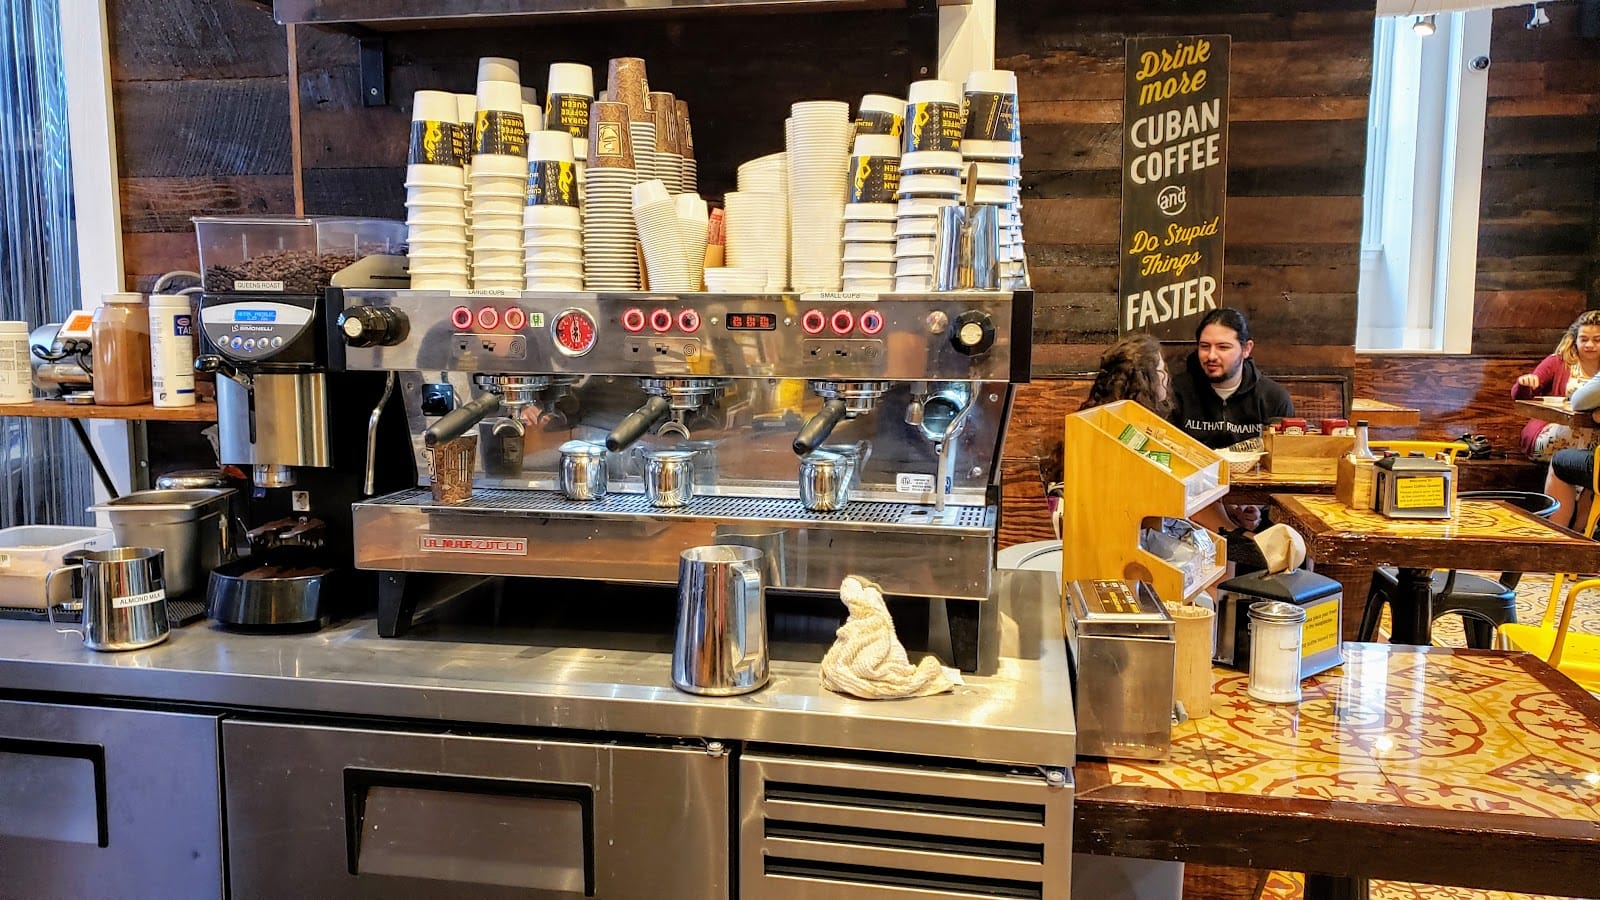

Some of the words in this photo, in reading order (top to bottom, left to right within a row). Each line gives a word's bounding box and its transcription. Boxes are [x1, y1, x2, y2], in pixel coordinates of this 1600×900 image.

[1135, 39, 1211, 81] Drink
[1138, 69, 1207, 106] more
[561, 100, 588, 109] QUEEN
[561, 108, 589, 117] COFFEE
[561, 116, 588, 126] CUBAN
[1130, 98, 1220, 148] CUBAN
[1130, 133, 1220, 184] COFFEE
[1160, 185, 1186, 210] and
[1129, 230, 1160, 255] Do
[1165, 216, 1219, 246] Stupid
[1141, 251, 1202, 277] Things
[1126, 276, 1217, 331] FASTER
[1185, 419, 1202, 430] ALL
[1202, 421, 1225, 431] THAT
[1226, 421, 1263, 434] REMAINS
[423, 538, 437, 548] LA
[120, 595, 149, 605] ALMOND
